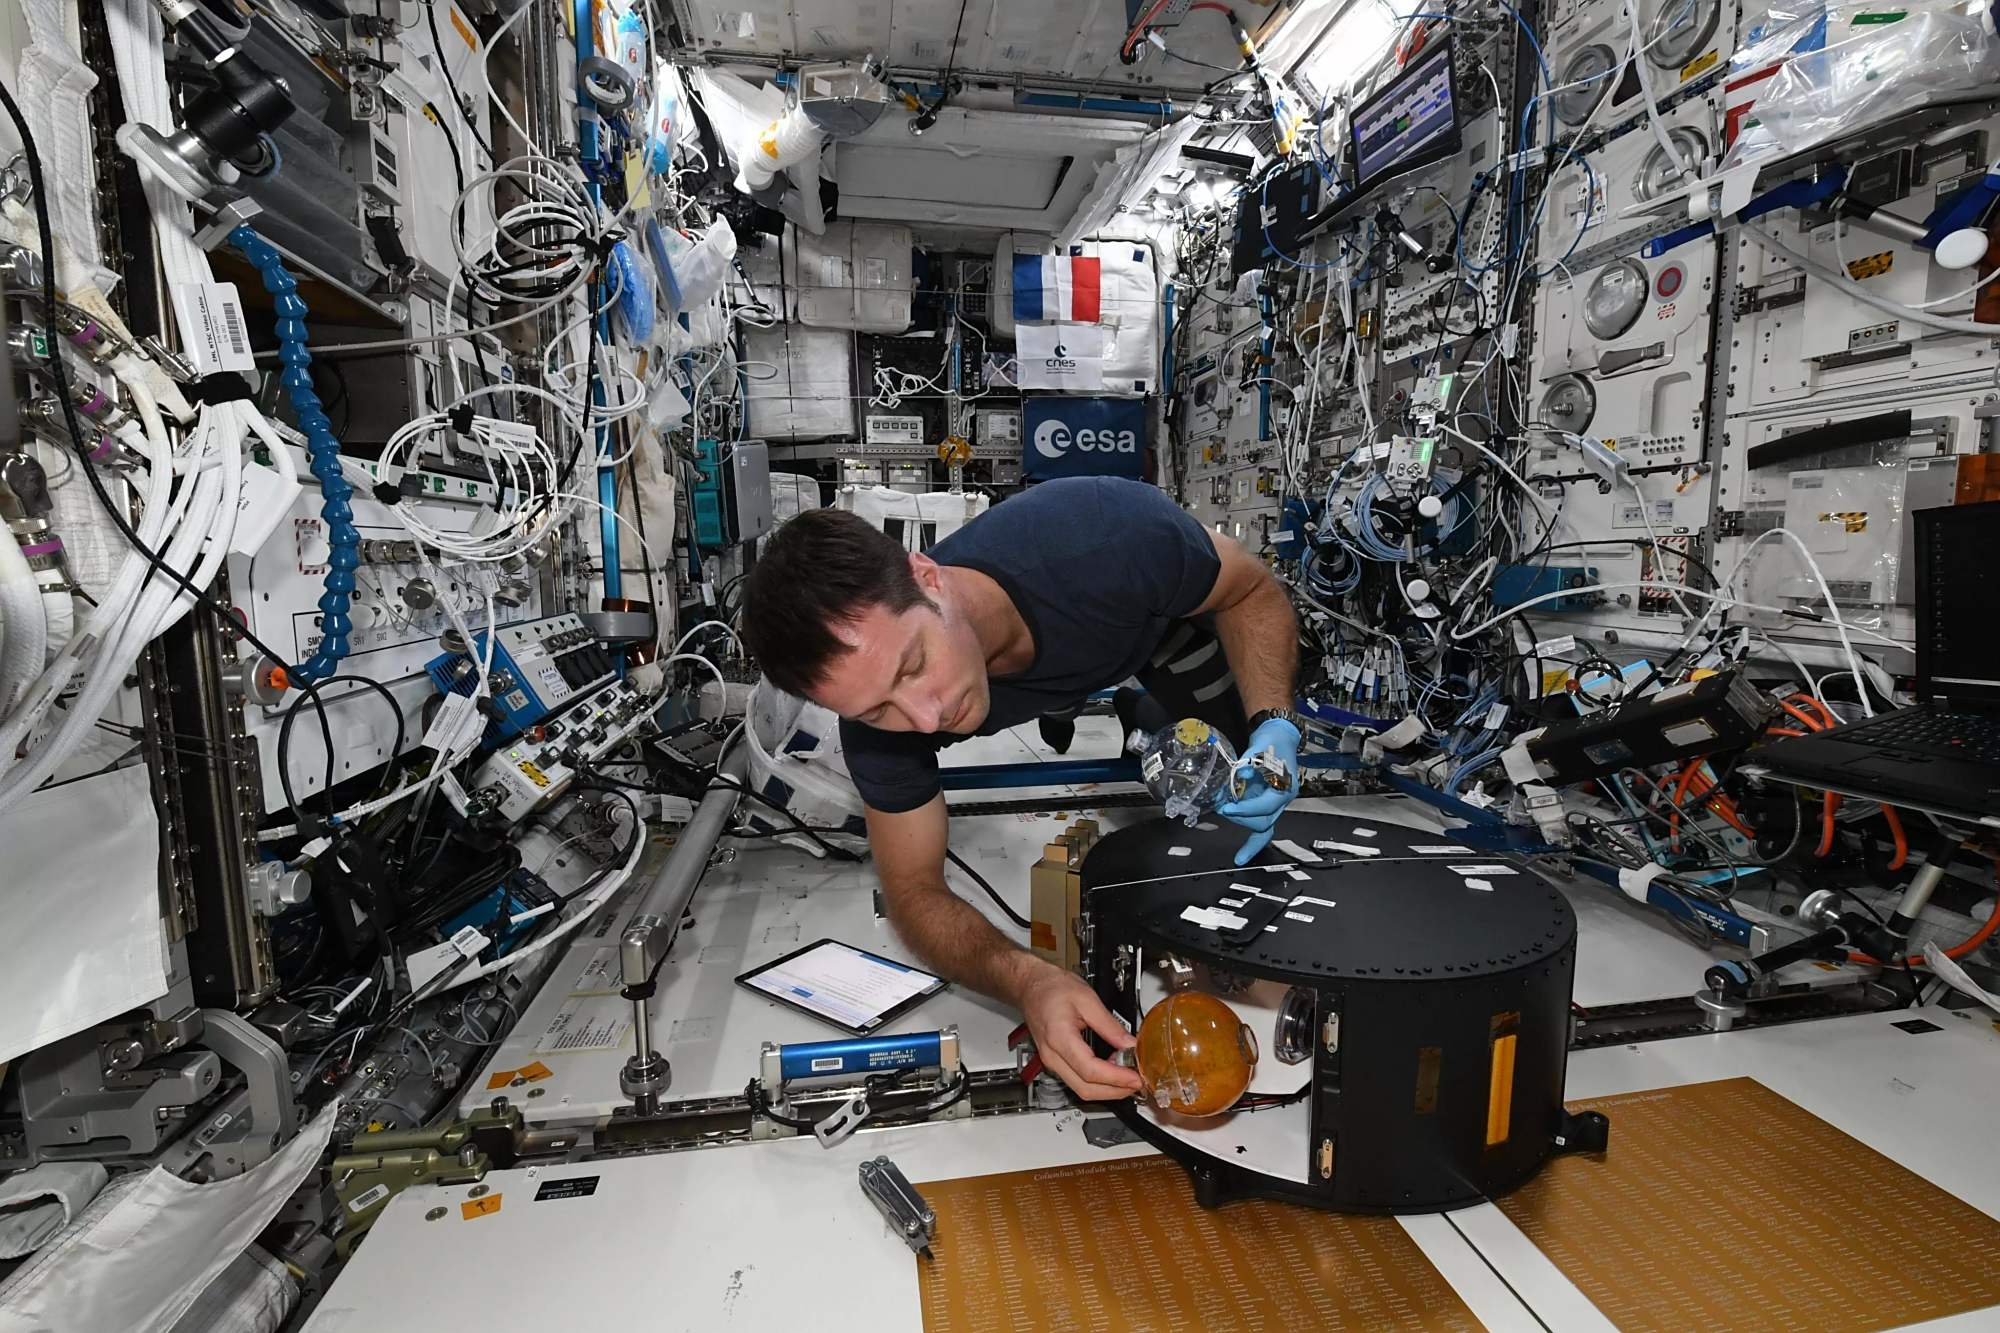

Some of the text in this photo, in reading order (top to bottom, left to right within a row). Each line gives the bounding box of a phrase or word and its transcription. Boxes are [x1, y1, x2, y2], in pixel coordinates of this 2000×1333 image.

[198, 296, 206, 313] Cable
[202, 314, 210, 332] Video
[1046, 358, 1076, 368] cnes
[1076, 428, 1136, 453] esa
[1033, 1170, 1075, 1181] Columbus
[1075, 1167, 1106, 1177] Module
